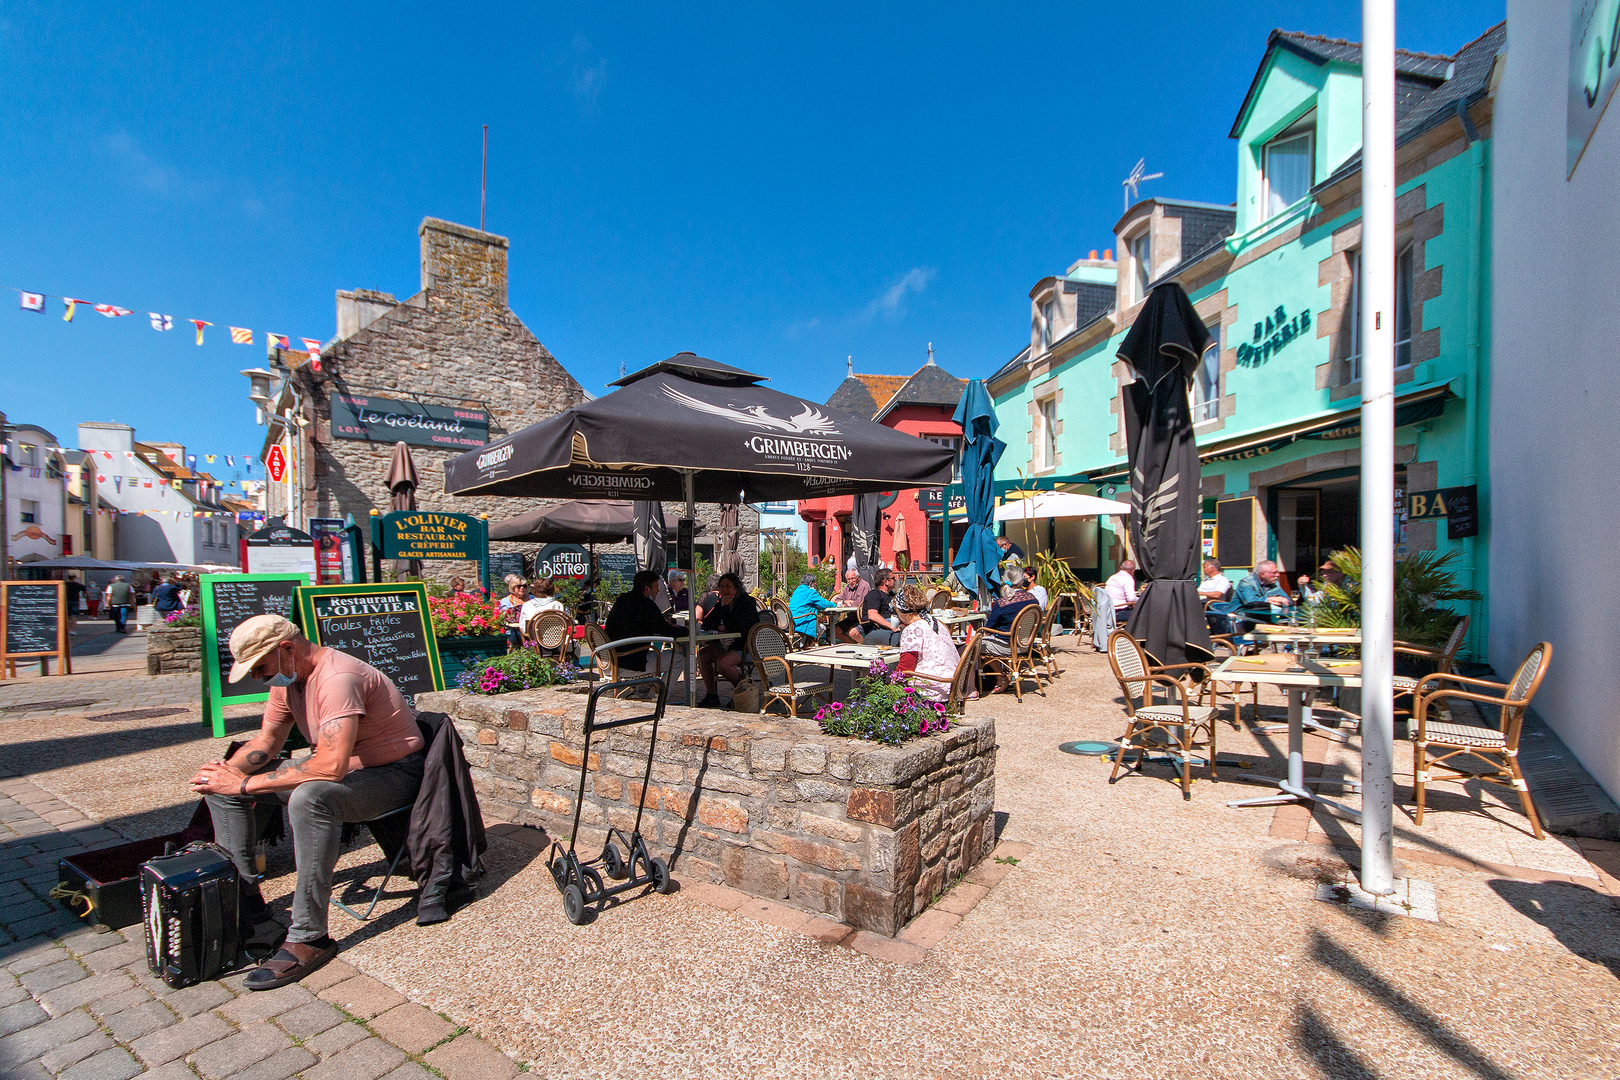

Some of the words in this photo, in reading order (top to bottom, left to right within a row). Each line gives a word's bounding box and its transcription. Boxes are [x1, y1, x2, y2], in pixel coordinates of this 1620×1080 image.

[1254, 305, 1287, 340] BAR
[358, 408, 381, 424] Le
[384, 412, 465, 433] Goéland
[453, 410, 484, 421] PRESSE
[338, 425, 368, 435] LOTO
[431, 434, 451, 444] CAVE
[750, 436, 848, 460] GRIMBERGEN
[272, 450, 281, 477] TABAC
[796, 462, 811, 472] 1128
[947, 500, 961, 508] AFÉ
[1410, 492, 1448, 517] BA
[395, 514, 467, 533] L'OLIVIER
[420, 525, 445, 533] BAR
[397, 532, 467, 541] RESTAURANT
[410, 540, 455, 549] CRÊPERIE
[553, 555, 560, 563] LE
[560, 552, 583, 563] PETIT
[538, 560, 590, 579] BISTROT
[330, 594, 400, 607] Restaurant
[315, 601, 416, 618] L'OLIVIER
